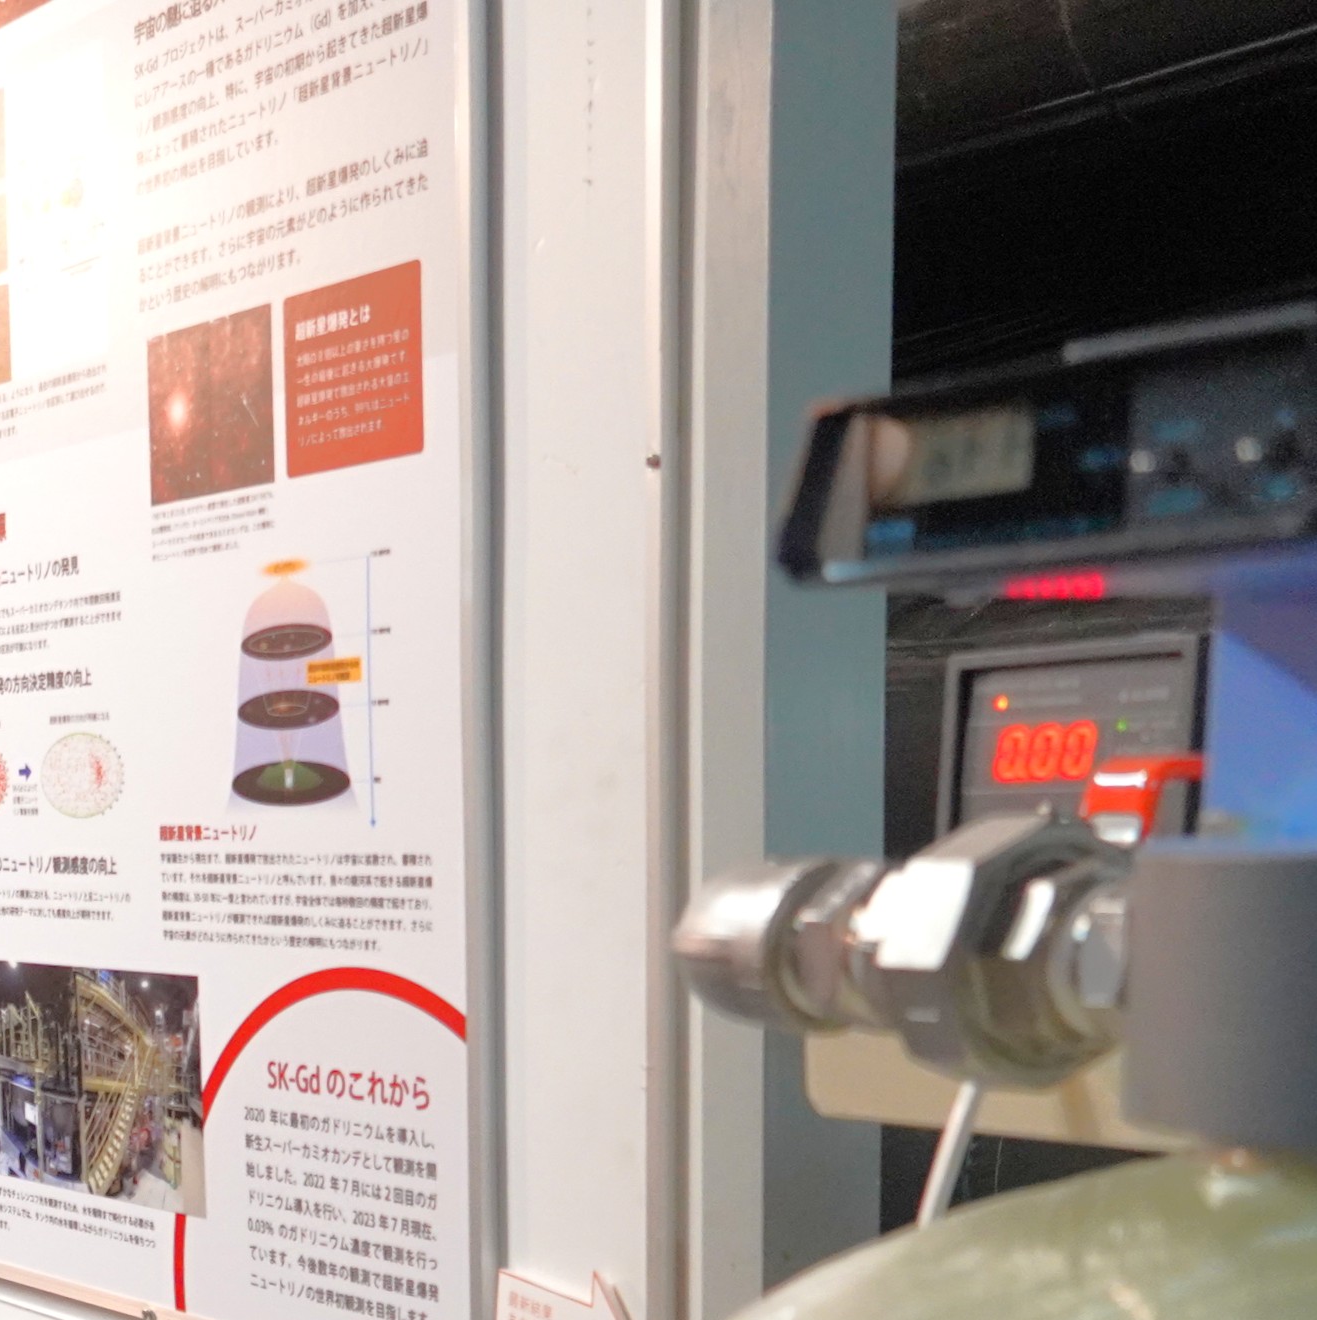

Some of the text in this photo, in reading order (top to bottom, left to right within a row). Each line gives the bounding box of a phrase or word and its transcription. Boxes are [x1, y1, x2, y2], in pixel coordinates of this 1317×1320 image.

[267, 1061, 430, 1110] SK-Gd のこれから
